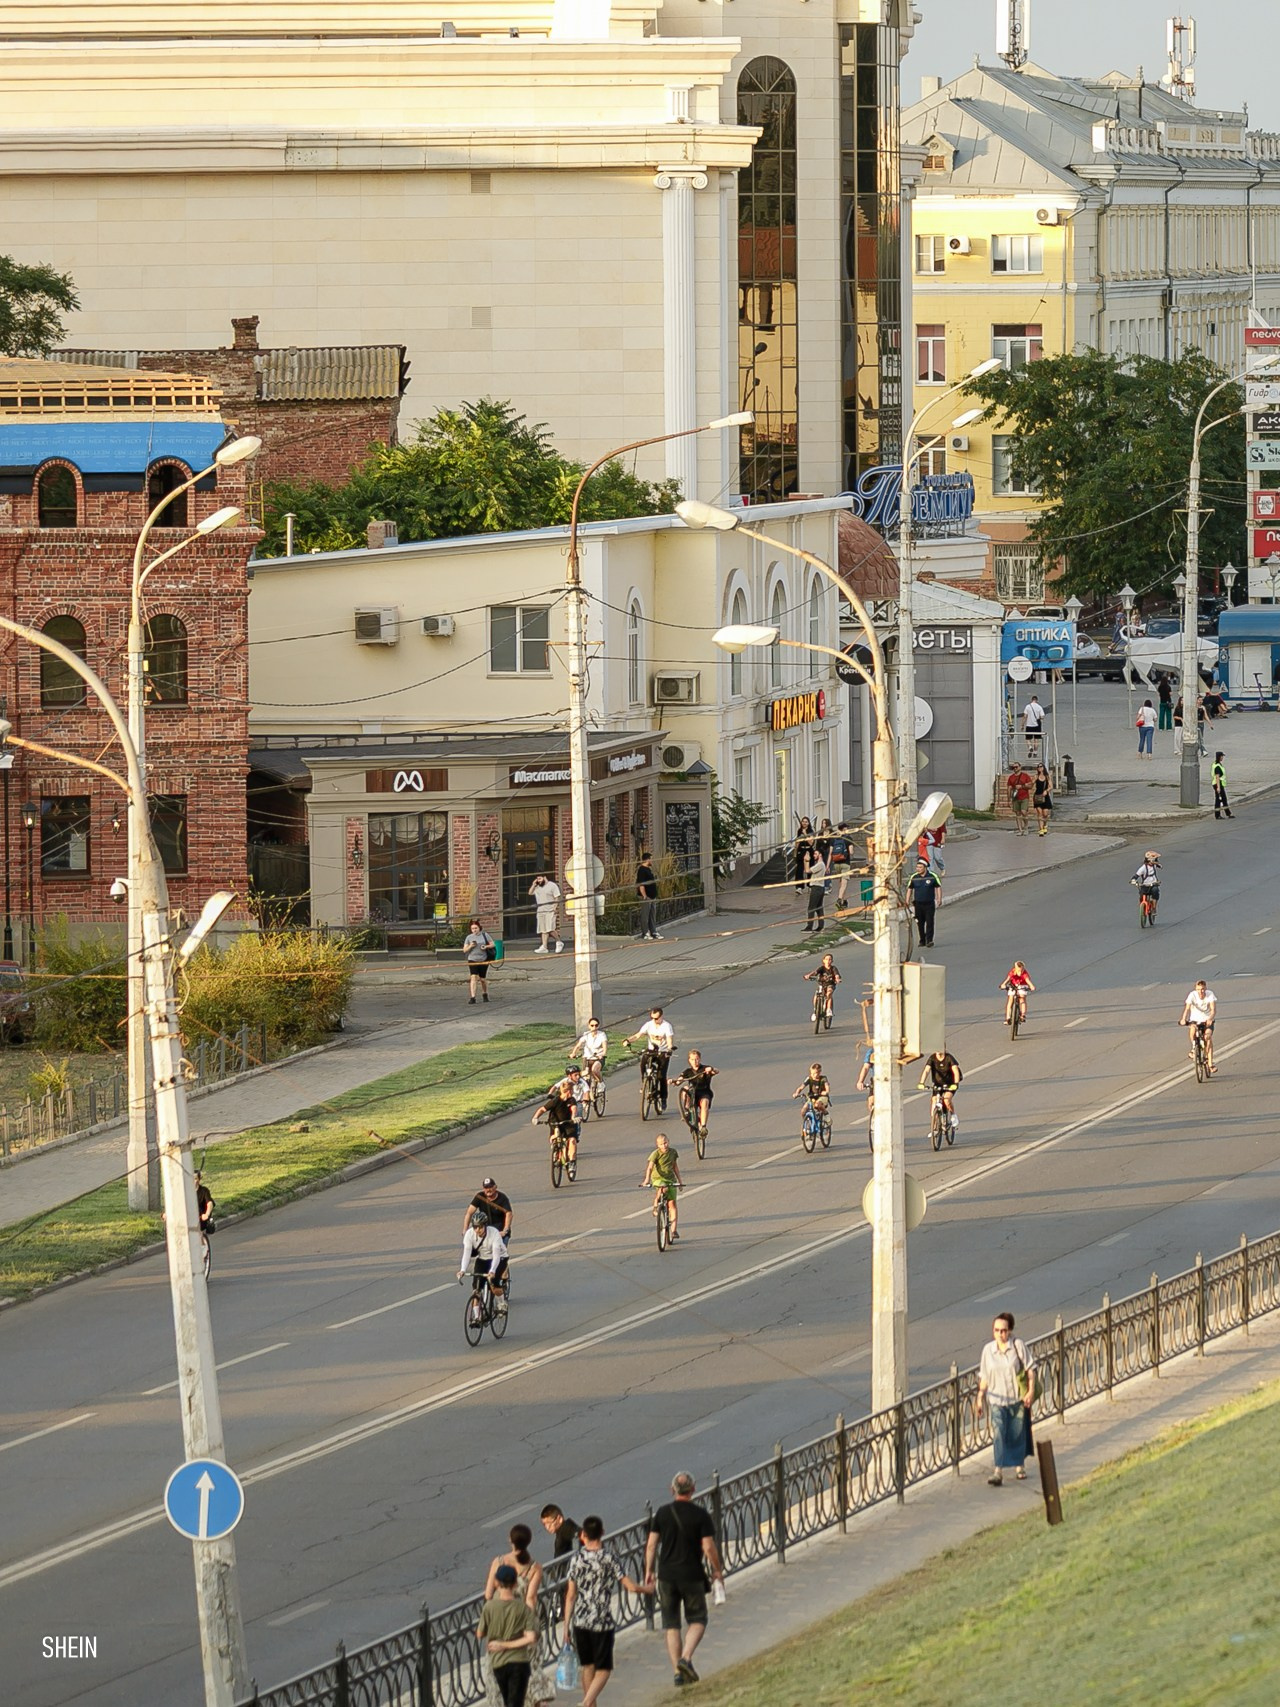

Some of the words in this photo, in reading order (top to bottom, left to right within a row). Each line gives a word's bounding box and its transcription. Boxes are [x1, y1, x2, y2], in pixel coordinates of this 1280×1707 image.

[1015, 628, 1071, 641] ОПТИКА
[773, 691, 816, 731] ПЕКАРНЯ
[514, 769, 571, 783] Macmarke
